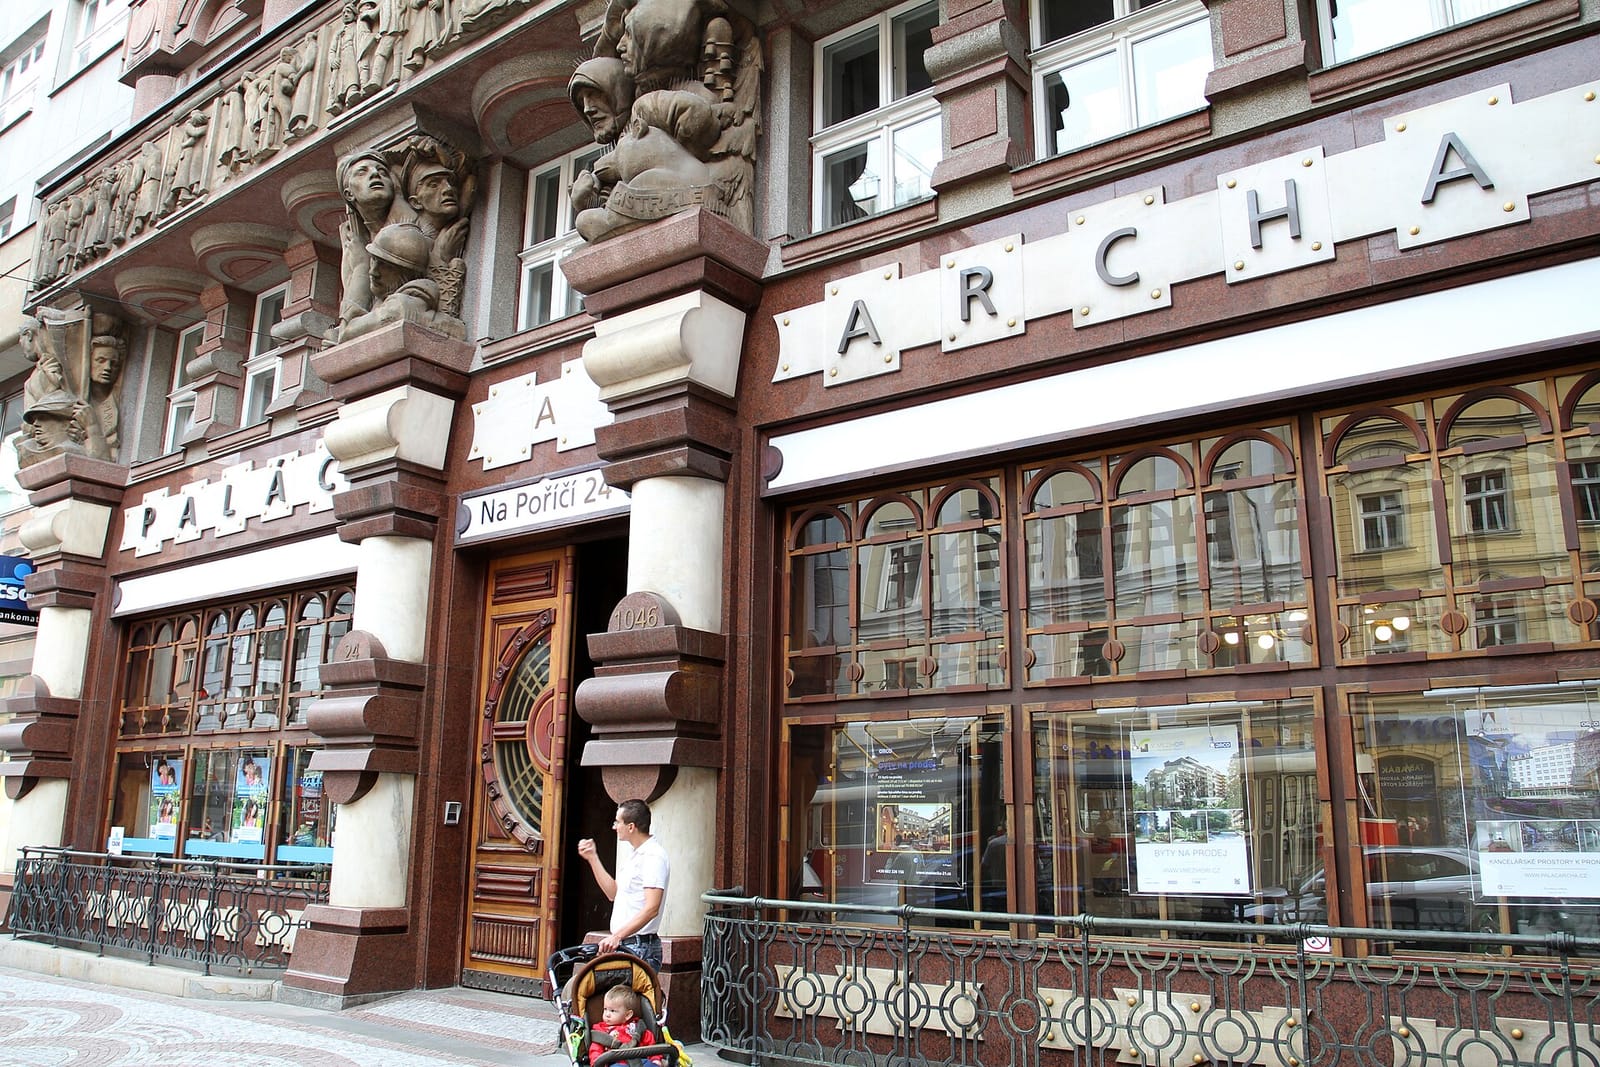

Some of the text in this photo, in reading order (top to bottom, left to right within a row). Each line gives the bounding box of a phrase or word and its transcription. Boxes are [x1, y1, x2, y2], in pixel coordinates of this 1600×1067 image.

[837, 131, 1495, 355] ARCHA
[534, 395, 557, 430] A
[141, 456, 336, 538] PALÁC
[481, 476, 613, 525] Na Poříčí 24
[614, 606, 659, 631] 1046
[344, 642, 360, 661] 24
[1154, 848, 1228, 857] BYTY NA PRODEJ
